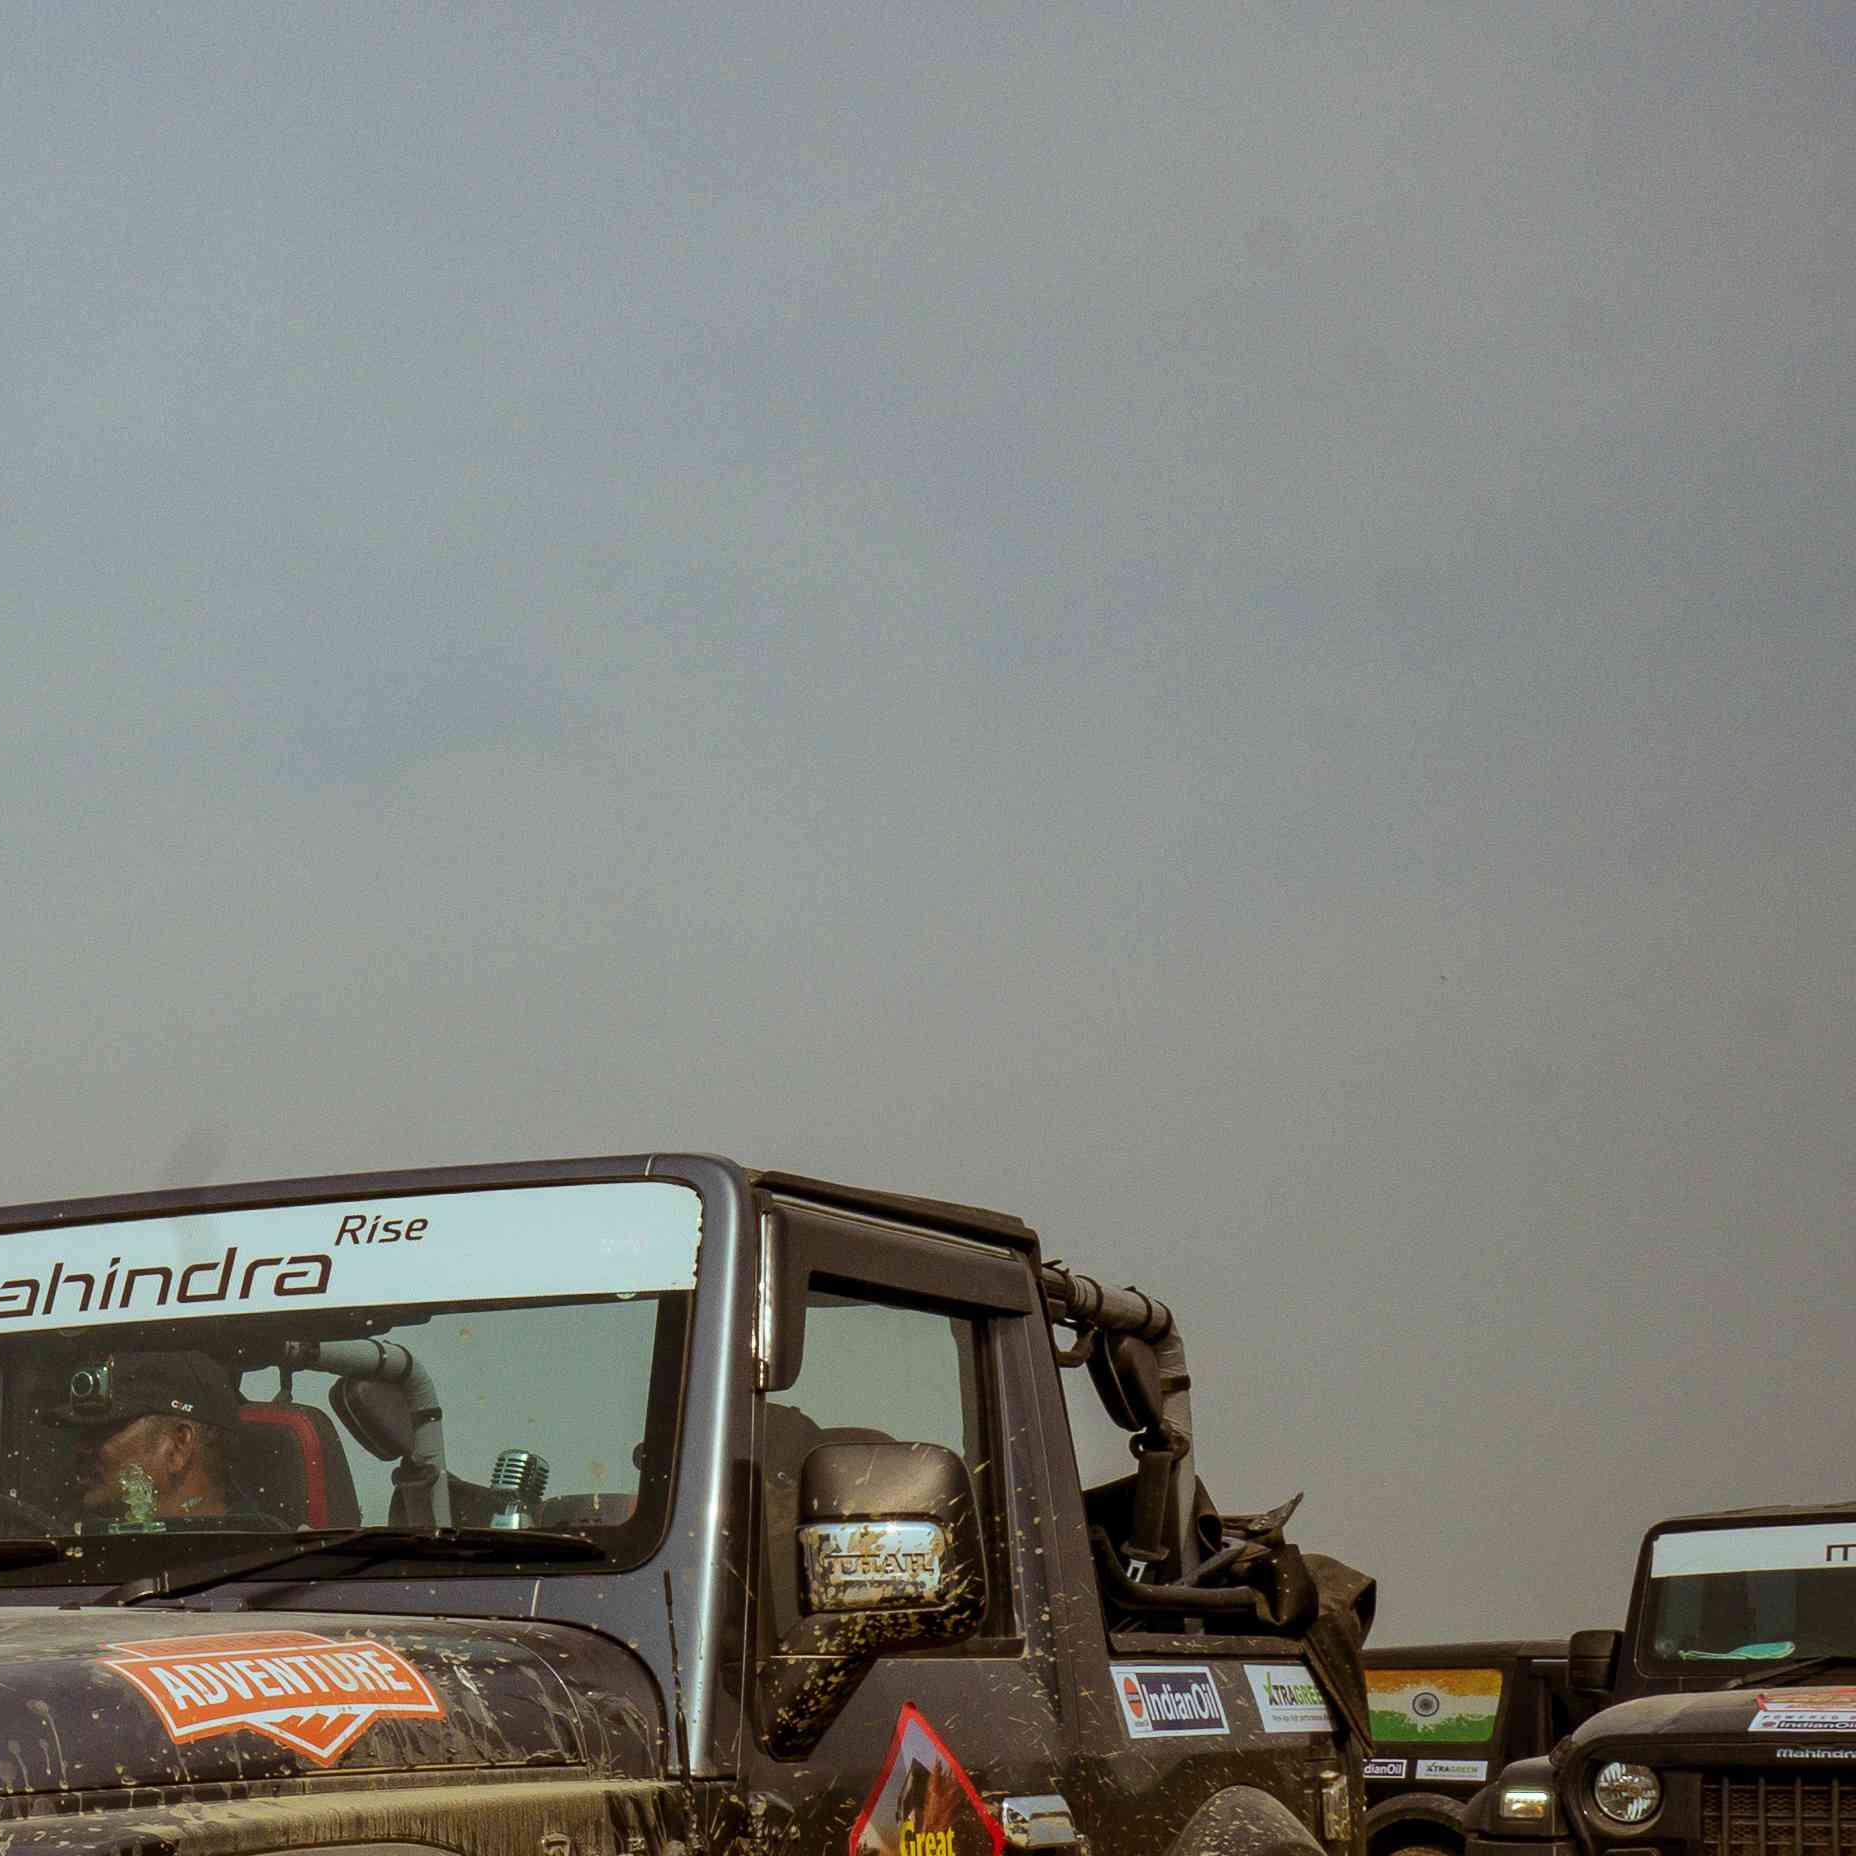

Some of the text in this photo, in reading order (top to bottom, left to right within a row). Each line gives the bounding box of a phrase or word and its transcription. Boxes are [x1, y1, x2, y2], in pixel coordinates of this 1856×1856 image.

[335, 1213, 429, 1247] Rise
[149, 1651, 412, 1710] ADVENTURE
[1141, 1682, 1221, 1721] IndianOil
[1779, 1721, 1856, 1729] IndianOi
[1363, 1763, 1403, 1776] dianOil
